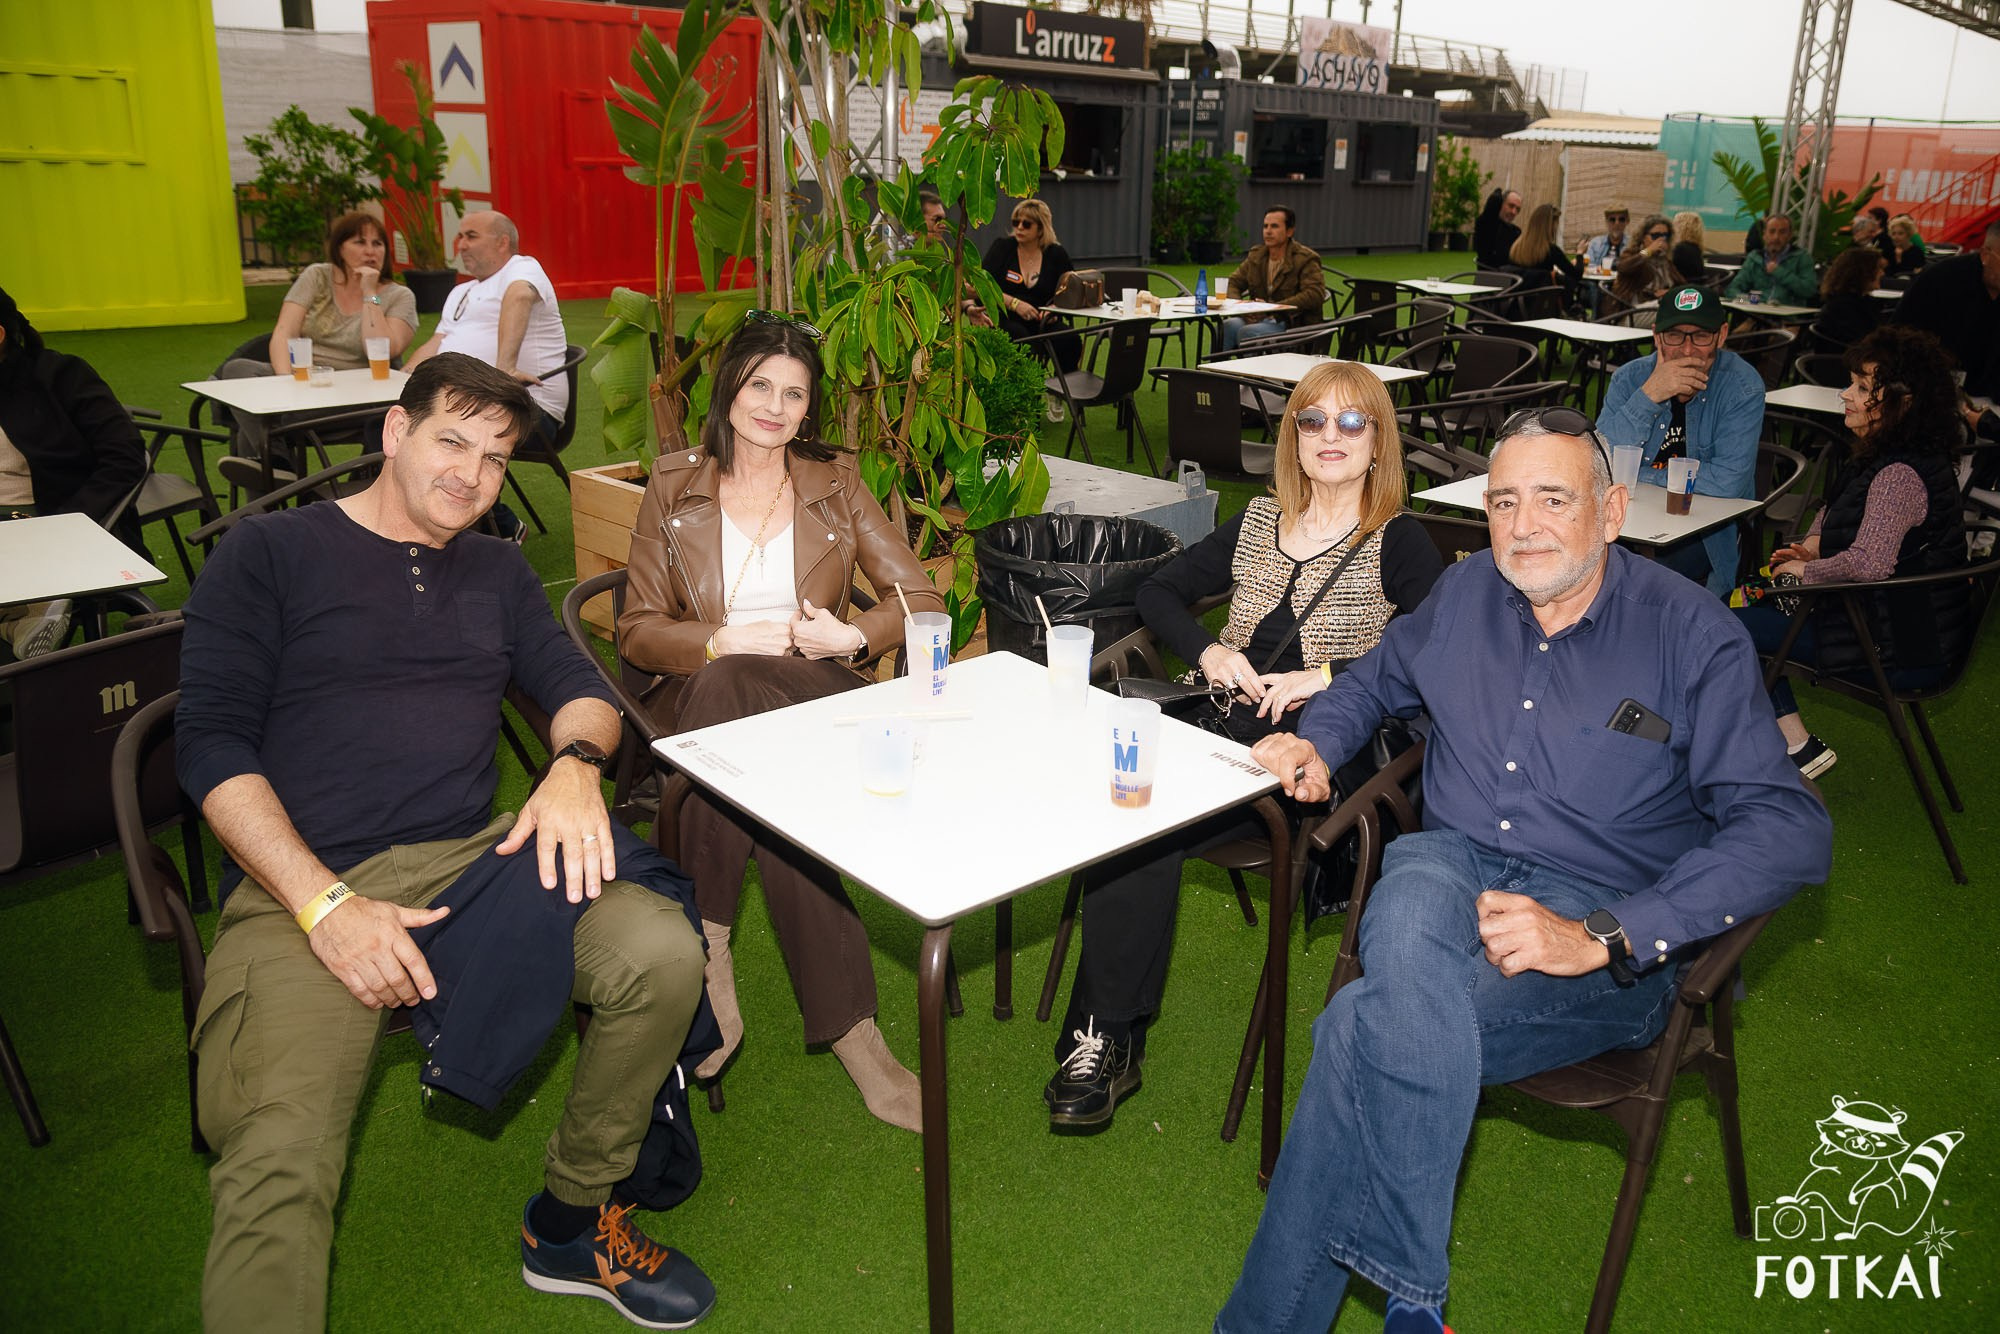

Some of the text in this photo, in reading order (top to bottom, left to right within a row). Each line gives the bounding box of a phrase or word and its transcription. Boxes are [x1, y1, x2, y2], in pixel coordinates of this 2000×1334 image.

[1114, 742, 1138, 772] M
[1115, 783, 1139, 793] MUELLE
[1116, 792, 1127, 801] LIVE
